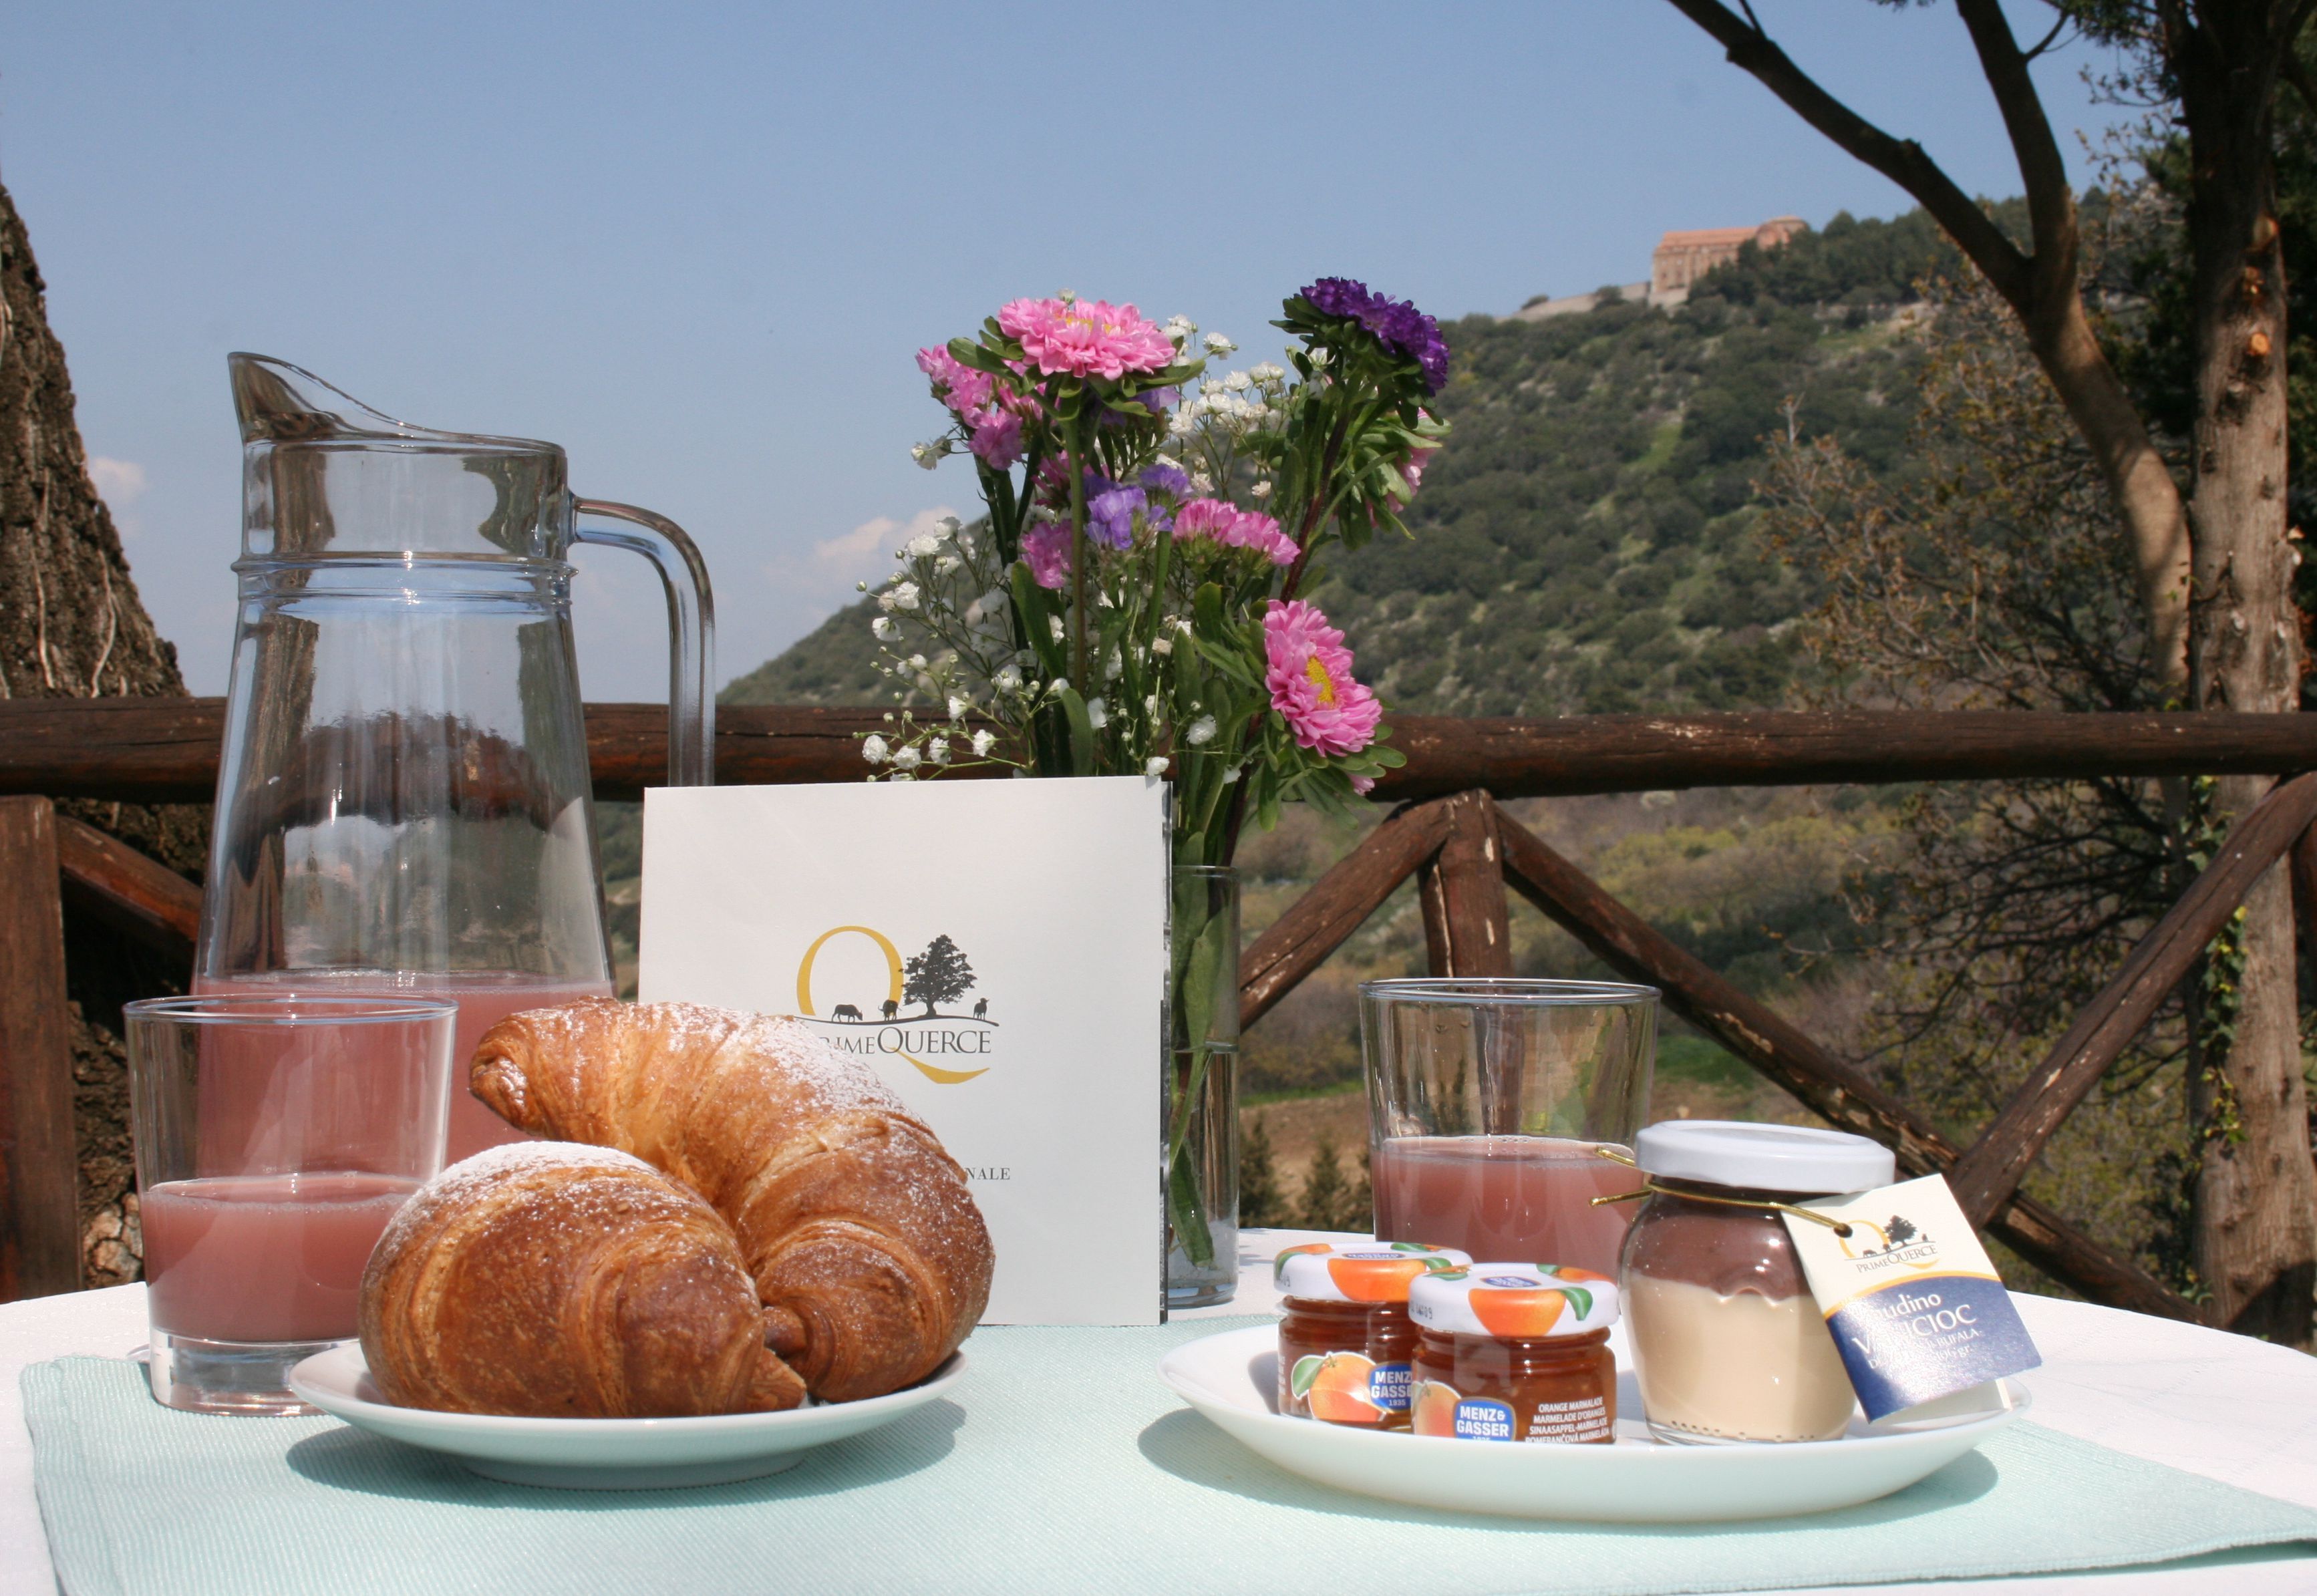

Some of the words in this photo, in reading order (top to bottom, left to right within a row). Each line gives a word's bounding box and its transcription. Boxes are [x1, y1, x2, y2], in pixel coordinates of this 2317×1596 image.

[818, 1026, 991, 1054] IMEQUERCE
[965, 1167, 1011, 1180] NALE
[1855, 1244, 1938, 1273] PRIMEQUERCE
[1880, 1293, 1942, 1319] udino
[1375, 1371, 1412, 1384] MENZ
[1371, 1385, 1412, 1399] GASSE
[1538, 1402, 1568, 1413] ORANGE
[1569, 1396, 1603, 1411] MARMALADE
[1459, 1406, 1506, 1422] MENZ&
[1533, 1412, 1577, 1424] MARMELADE
[1456, 1420, 1509, 1437] GASSER
